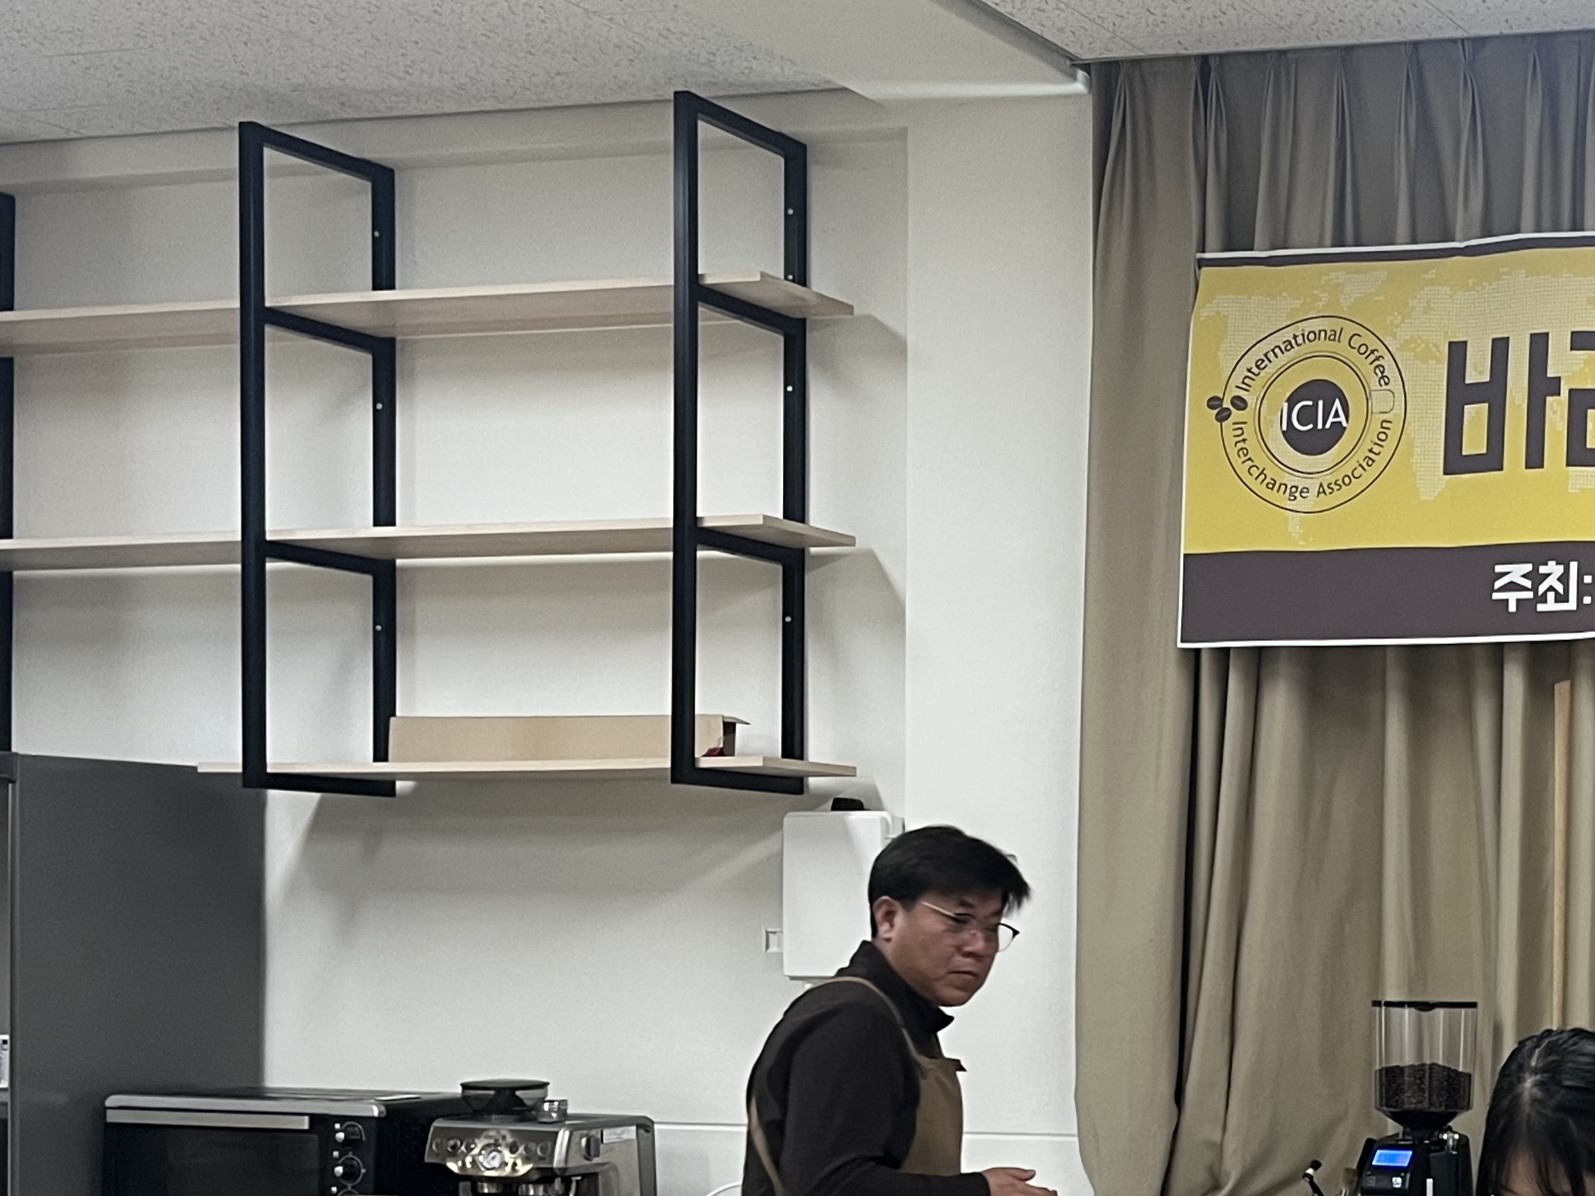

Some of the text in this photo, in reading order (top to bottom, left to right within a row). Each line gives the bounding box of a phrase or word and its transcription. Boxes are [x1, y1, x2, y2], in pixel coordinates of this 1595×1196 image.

[1235, 327, 1391, 393] International Coffee
[1281, 398, 1348, 431] ICIA
[1232, 419, 1392, 501] Interchange Association
[1491, 560, 1593, 613] 주최:
